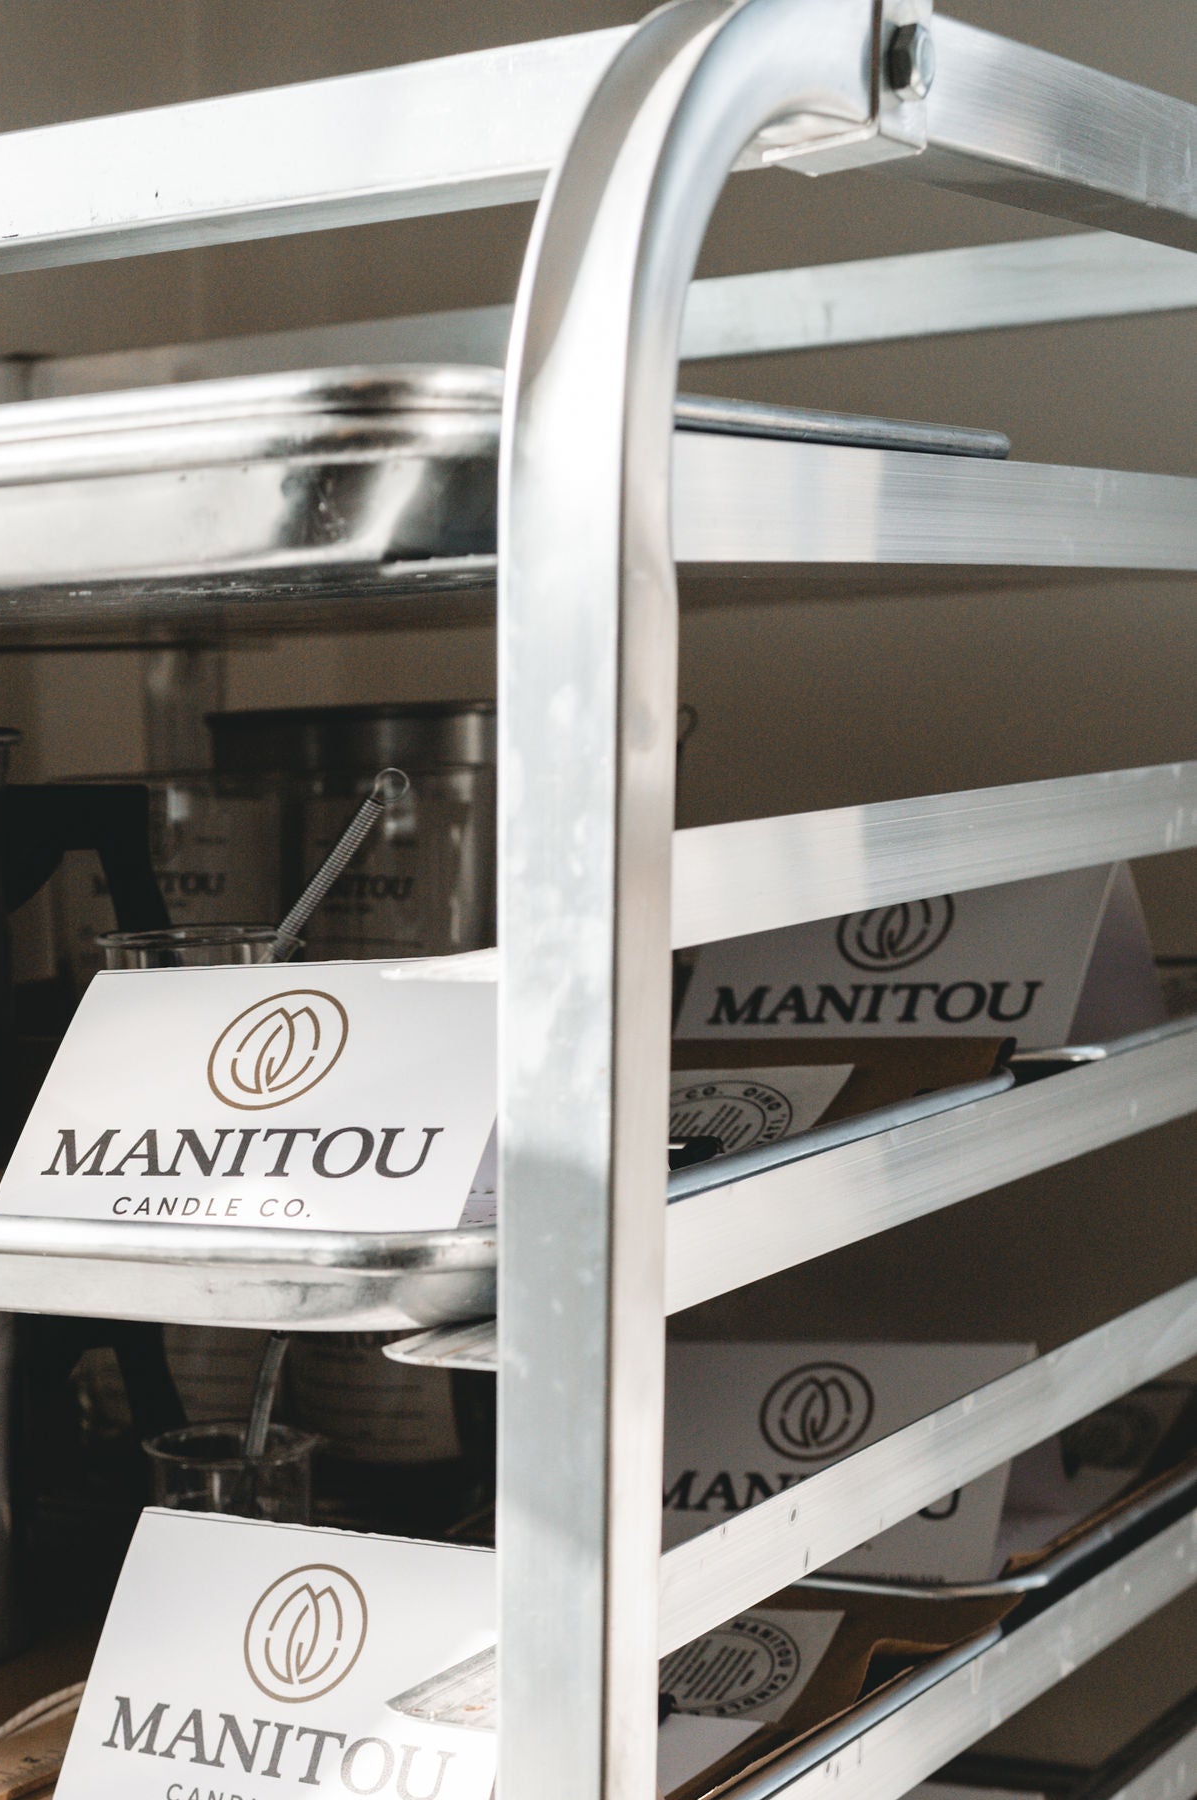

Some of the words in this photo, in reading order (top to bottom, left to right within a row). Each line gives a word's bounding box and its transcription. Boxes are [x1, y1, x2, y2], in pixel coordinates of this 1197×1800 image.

[707, 980, 1043, 1026] MANITOU
[41, 1126, 445, 1179] MANITOU
[112, 1196, 243, 1217] CANDLE
[259, 1198, 311, 1218] CO.
